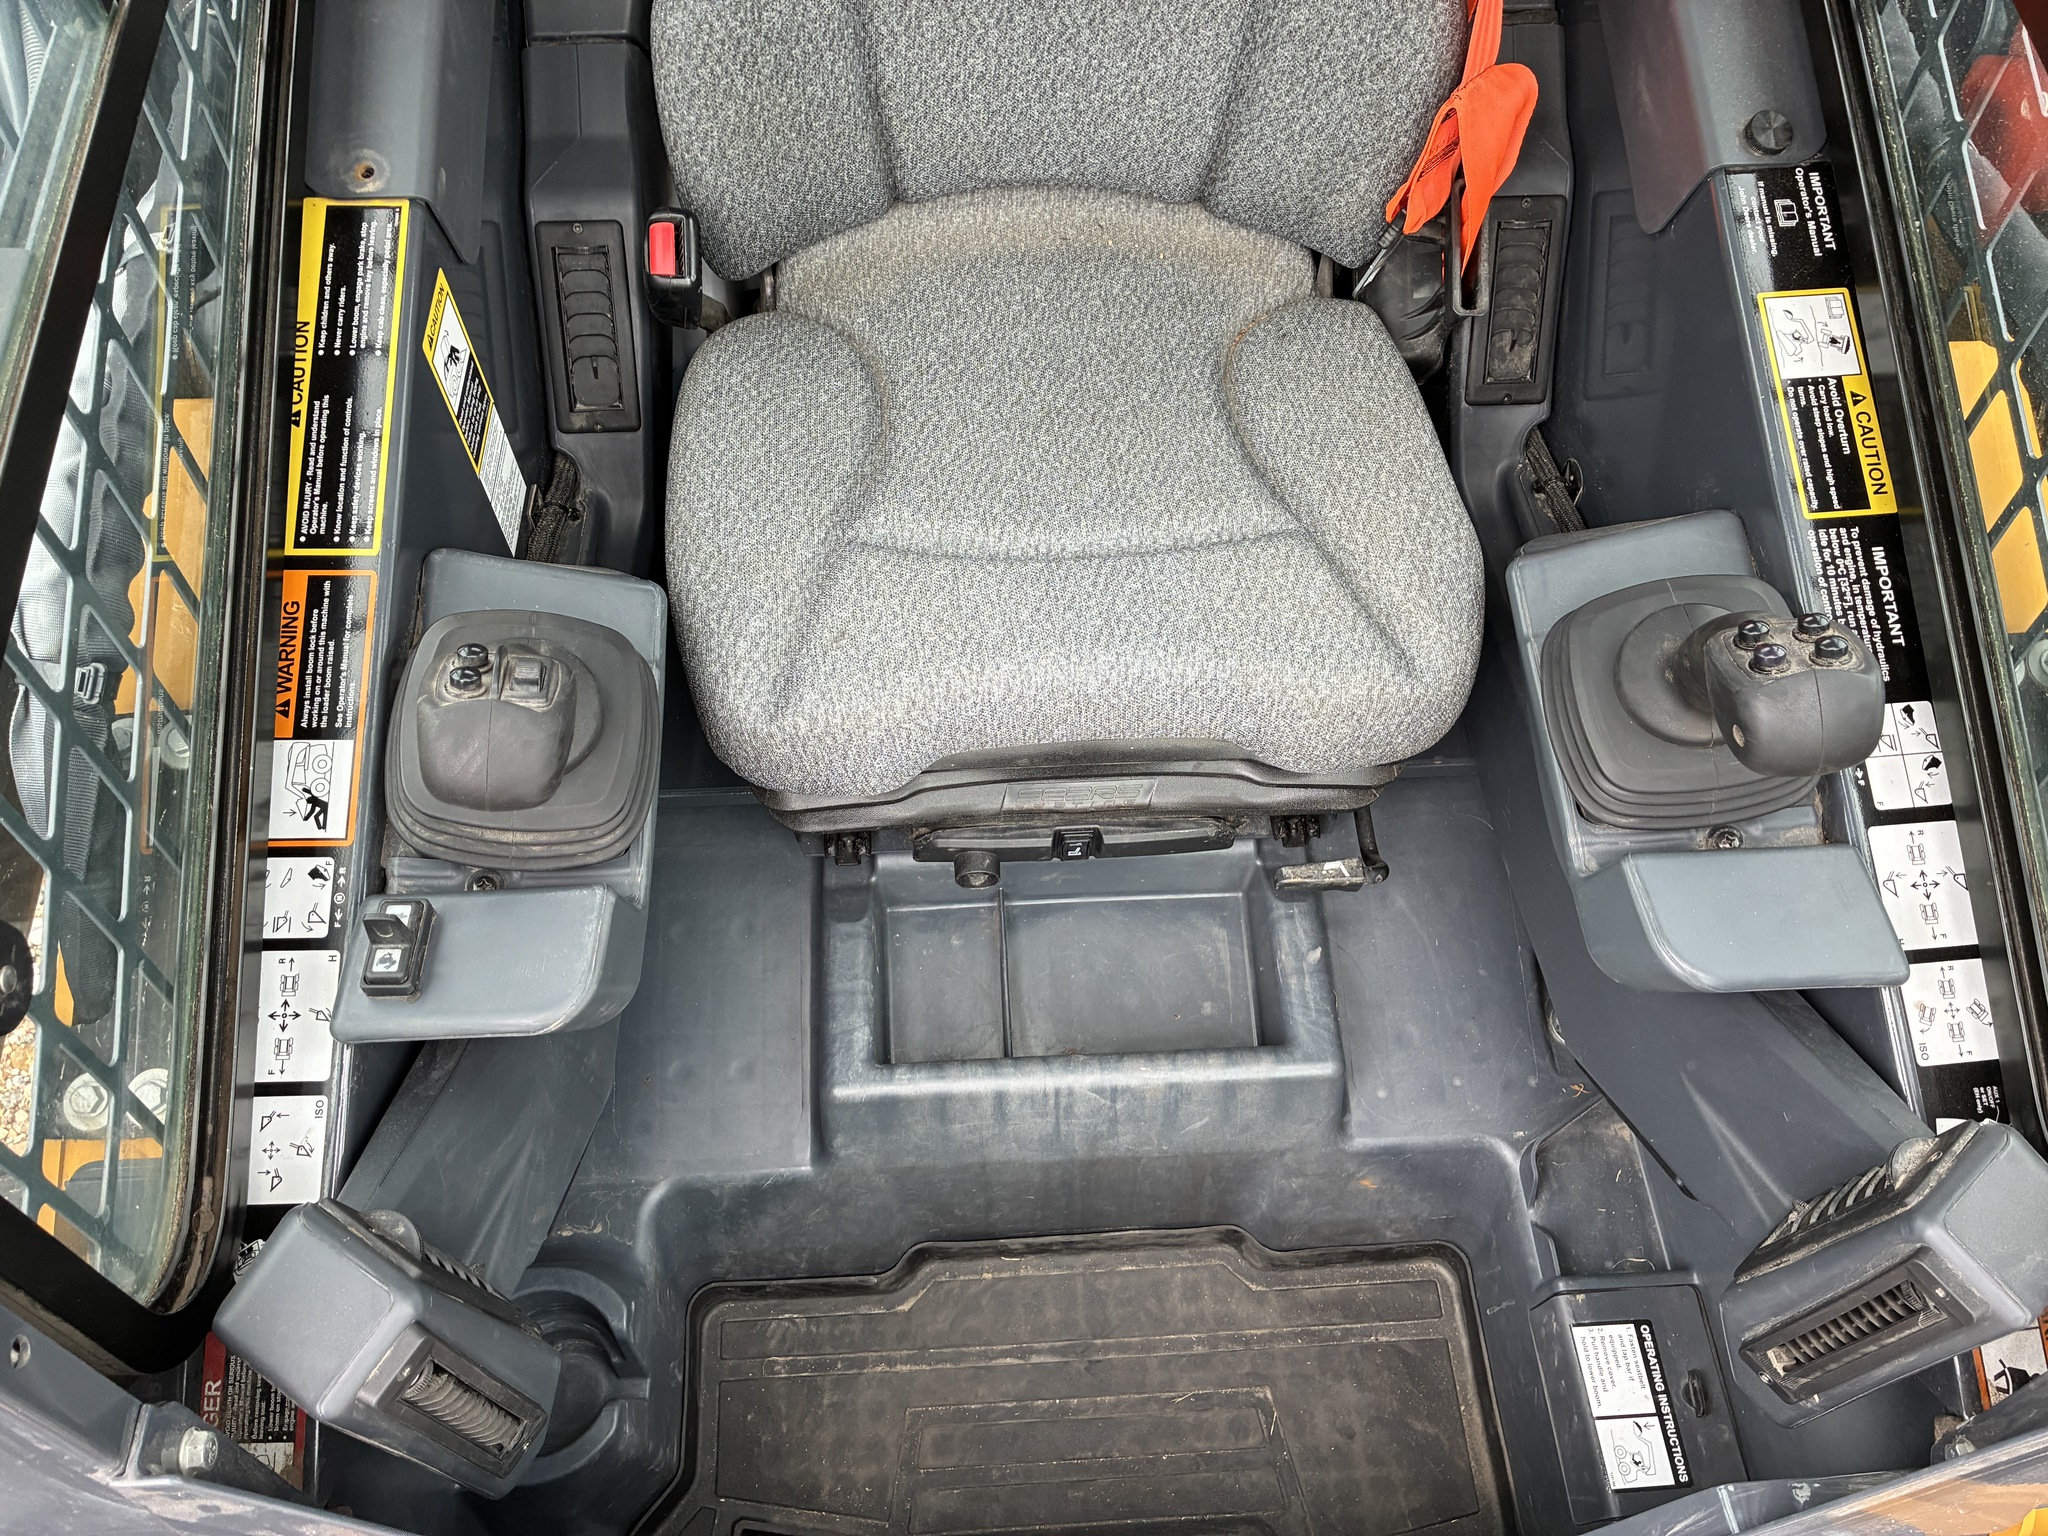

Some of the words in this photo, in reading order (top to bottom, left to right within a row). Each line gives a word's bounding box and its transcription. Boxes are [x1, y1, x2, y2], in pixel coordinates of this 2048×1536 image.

[1738, 186, 1748, 205] John
[1742, 207, 1752, 228] Deere
[1751, 196, 1762, 224] contact
[1794, 168, 1813, 219] Operator's
[1807, 221, 1823, 256] Manual
[1808, 172, 1836, 250] IMPORTANT
[360, 222, 369, 237] stop
[367, 219, 378, 246] leaving.
[1759, 188, 1771, 215] manual
[1767, 225, 1778, 257] missing,
[1747, 230, 1757, 254] dealer.
[1754, 226, 1765, 243] your
[328, 243, 336, 262] away.
[357, 239, 367, 259] brake,
[365, 247, 374, 269] before
[383, 240, 392, 258] pedal
[324, 264, 332, 285] others
[356, 261, 365, 276] park
[364, 270, 374, 282] key
[381, 260, 391, 293] especially
[338, 285, 346, 307] riders.
[355, 277, 364, 302] engage
[320, 301, 329, 328] children
[352, 303, 361, 325] boom,
[378, 295, 388, 315] clean,
[430, 283, 444, 336] CAUTION
[338, 309, 346, 326] carry
[318, 330, 328, 348] Keep
[334, 328, 342, 348] Never
[350, 327, 358, 348] Lower
[360, 325, 368, 348] engine
[375, 331, 386, 348] Keep
[293, 321, 310, 405] CAUTION
[321, 395, 329, 408] this
[1787, 387, 1795, 397] Do
[1797, 386, 1806, 407] turns.
[1808, 385, 1819, 405] Avoid
[1818, 385, 1827, 404] Carry
[1827, 377, 1843, 407] Avoid
[1789, 398, 1798, 410] not
[1822, 406, 1833, 421] load
[310, 401, 320, 441] understand
[320, 409, 330, 443] operating
[373, 407, 382, 428] place.
[1792, 412, 1803, 439] operate
[1812, 407, 1821, 426] steep
[342, 428, 350, 436] of
[1816, 428, 1827, 451] slopes
[1826, 423, 1834, 438] low.
[1834, 410, 1851, 454] Overturn
[316, 445, 325, 467] before
[339, 437, 349, 466] function
[356, 431, 366, 462] working.
[370, 438, 379, 469] windows
[1798, 441, 1807, 456] over
[1856, 411, 1888, 495] CAUTION
[306, 457, 315, 476] Read
[1802, 458, 1813, 477] rated
[1822, 454, 1832, 467] and
[313, 469, 323, 495] Manual
[353, 463, 362, 491] devices
[1824, 469, 1835, 484] high
[303, 482, 312, 509] INJURY
[335, 483, 345, 512] location
[351, 492, 361, 514] safety
[1806, 479, 1818, 510] capacity.
[1828, 487, 1840, 509] speed
[301, 510, 310, 534] AVOID
[310, 496, 320, 534] Operator's
[320, 502, 328, 534] machine.
[334, 513, 342, 534] Know
[349, 515, 359, 534] Keep
[364, 515, 374, 534] Keep
[1818, 529, 1829, 546] idle
[1839, 527, 1851, 546] and
[1850, 526, 1859, 538] To
[1806, 529, 1824, 575] operation
[1819, 576, 1829, 587] of
[1822, 548, 1832, 562] for
[1843, 547, 1857, 582] engine,
[1850, 541, 1868, 577] prevent
[1826, 564, 1836, 576] 10
[1829, 528, 1841, 557] below
[1847, 611, 1856, 627] run
[323, 580, 331, 596] with
[1829, 577, 1843, 616] minutes
[1852, 585, 1861, 594] in
[1861, 578, 1876, 617] damage
[1871, 546, 1905, 646] IMPORTANT
[309, 609, 318, 633] before
[321, 598, 329, 630] machine
[345, 595, 354, 629] complete
[1870, 619, 1880, 629] of
[308, 634, 316, 650] lock
[318, 631, 326, 645] this
[342, 630, 350, 641] for
[277, 601, 299, 695] WARNING
[326, 639, 335, 665] raised.
[340, 643, 349, 670] Manual
[1871, 631, 1890, 682] hydraulics
[306, 652, 314, 674] boom
[317, 647, 325, 674] around
[303, 675, 312, 698] install
[316, 675, 322, 684] or
[323, 666, 332, 688] boom
[315, 685, 321, 695] on
[336, 672, 347, 711] Operator's
[312, 697, 322, 728] working
[321, 690, 330, 713] loader
[344, 680, 355, 728] instructions.
[301, 700, 312, 728] Always
[320, 715, 328, 728] the
[335, 713, 343, 728] See
[1017, 784, 1144, 801] SEARS
[1919, 1043, 1929, 1061] ISO
[1981, 1095, 1989, 1106] SET
[1992, 1086, 2000, 1098] AUX
[315, 1100, 324, 1119] ISO
[1589, 1336, 1600, 1350] Pull
[1608, 1334, 1622, 1371] equipped.
[1580, 1336, 1592, 1352] hold
[1587, 1363, 1597, 1383] lower
[1592, 1385, 1602, 1409] boom.
[1593, 1352, 1605, 1377] handle
[1599, 1335, 1611, 1365] Remove
[1606, 1367, 1616, 1389] cover.
[1627, 1334, 1638, 1358] Fasten
[1633, 1360, 1647, 1389] seatbelt
[1599, 1378, 1610, 1392] and
[1640, 1324, 1665, 1391] OPERATING
[1657, 1394, 1688, 1482] INSTRUCTIONS
